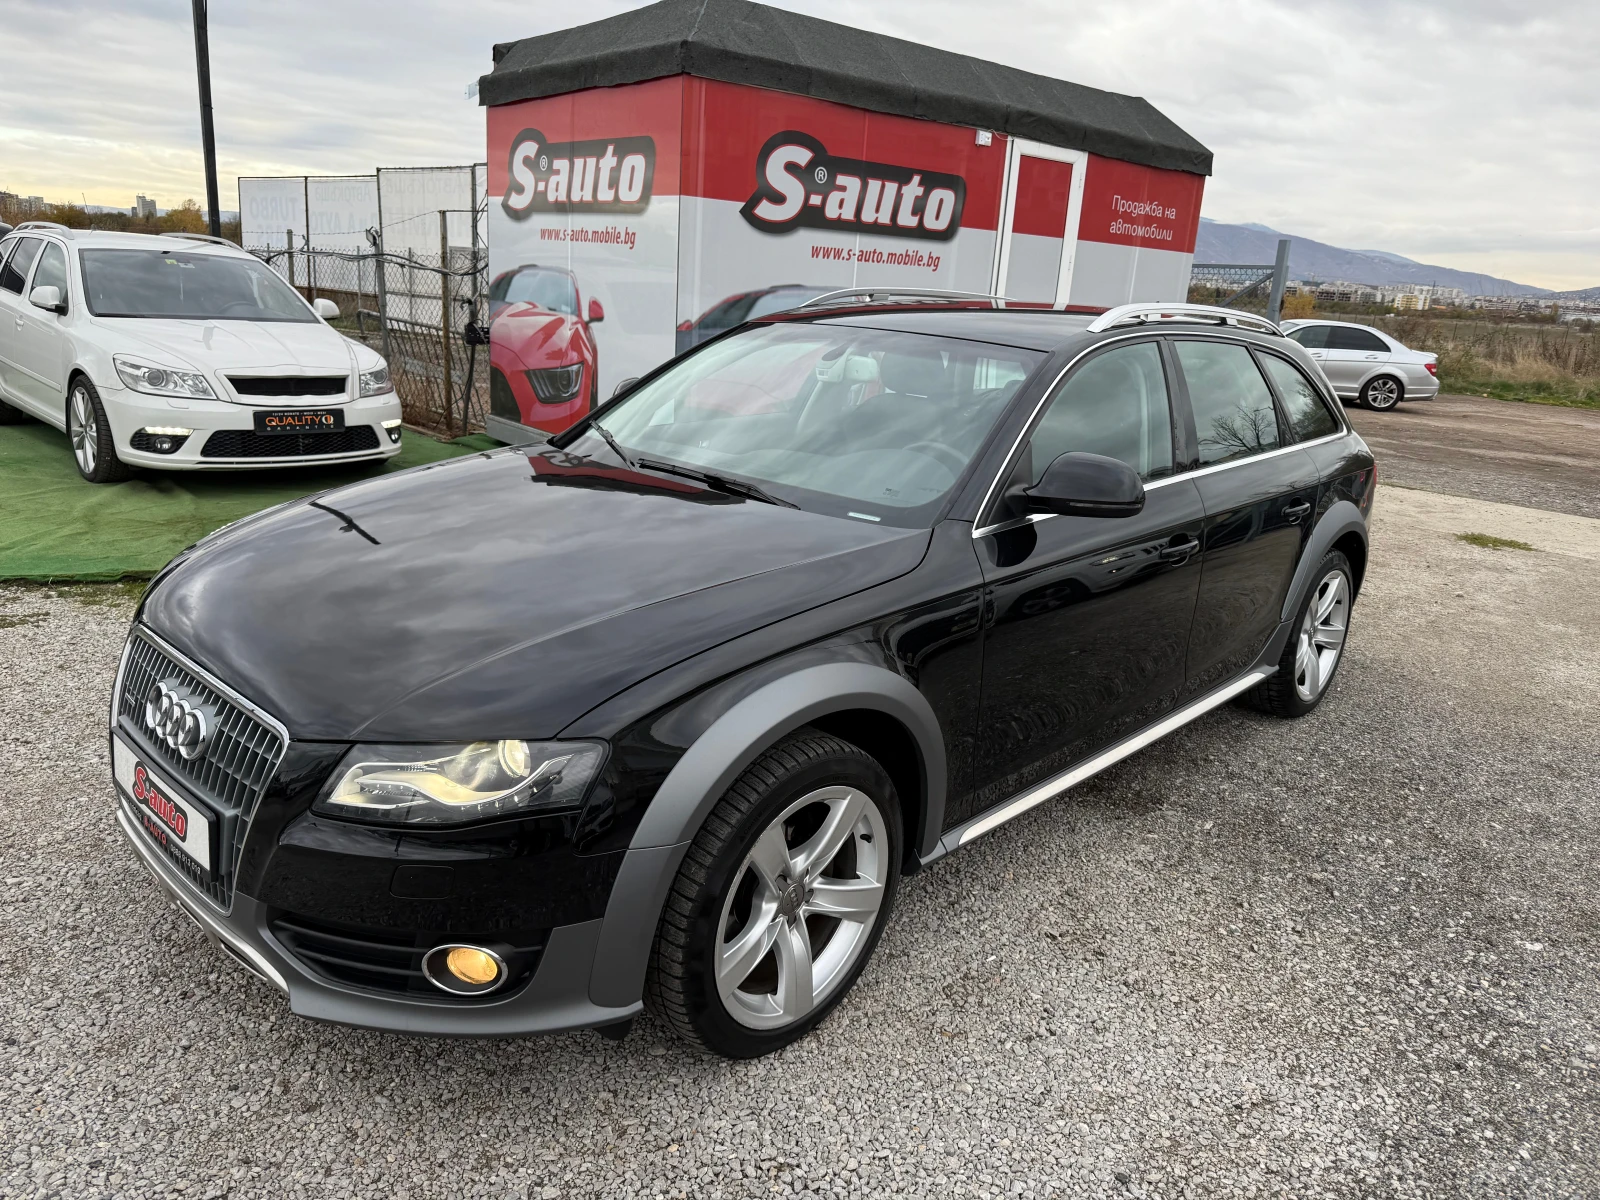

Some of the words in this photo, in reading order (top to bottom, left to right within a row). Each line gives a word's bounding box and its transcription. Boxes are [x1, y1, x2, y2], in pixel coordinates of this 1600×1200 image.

[1112, 195, 1162, 217] Продажба
[1164, 207, 1176, 219] на
[539, 226, 637, 250] www.s-auto.mobile.bg
[1110, 219, 1173, 240] автомобили
[811, 243, 941, 271] www.s-auto.mobile.bg
[266, 415, 321, 426] QUALITY
